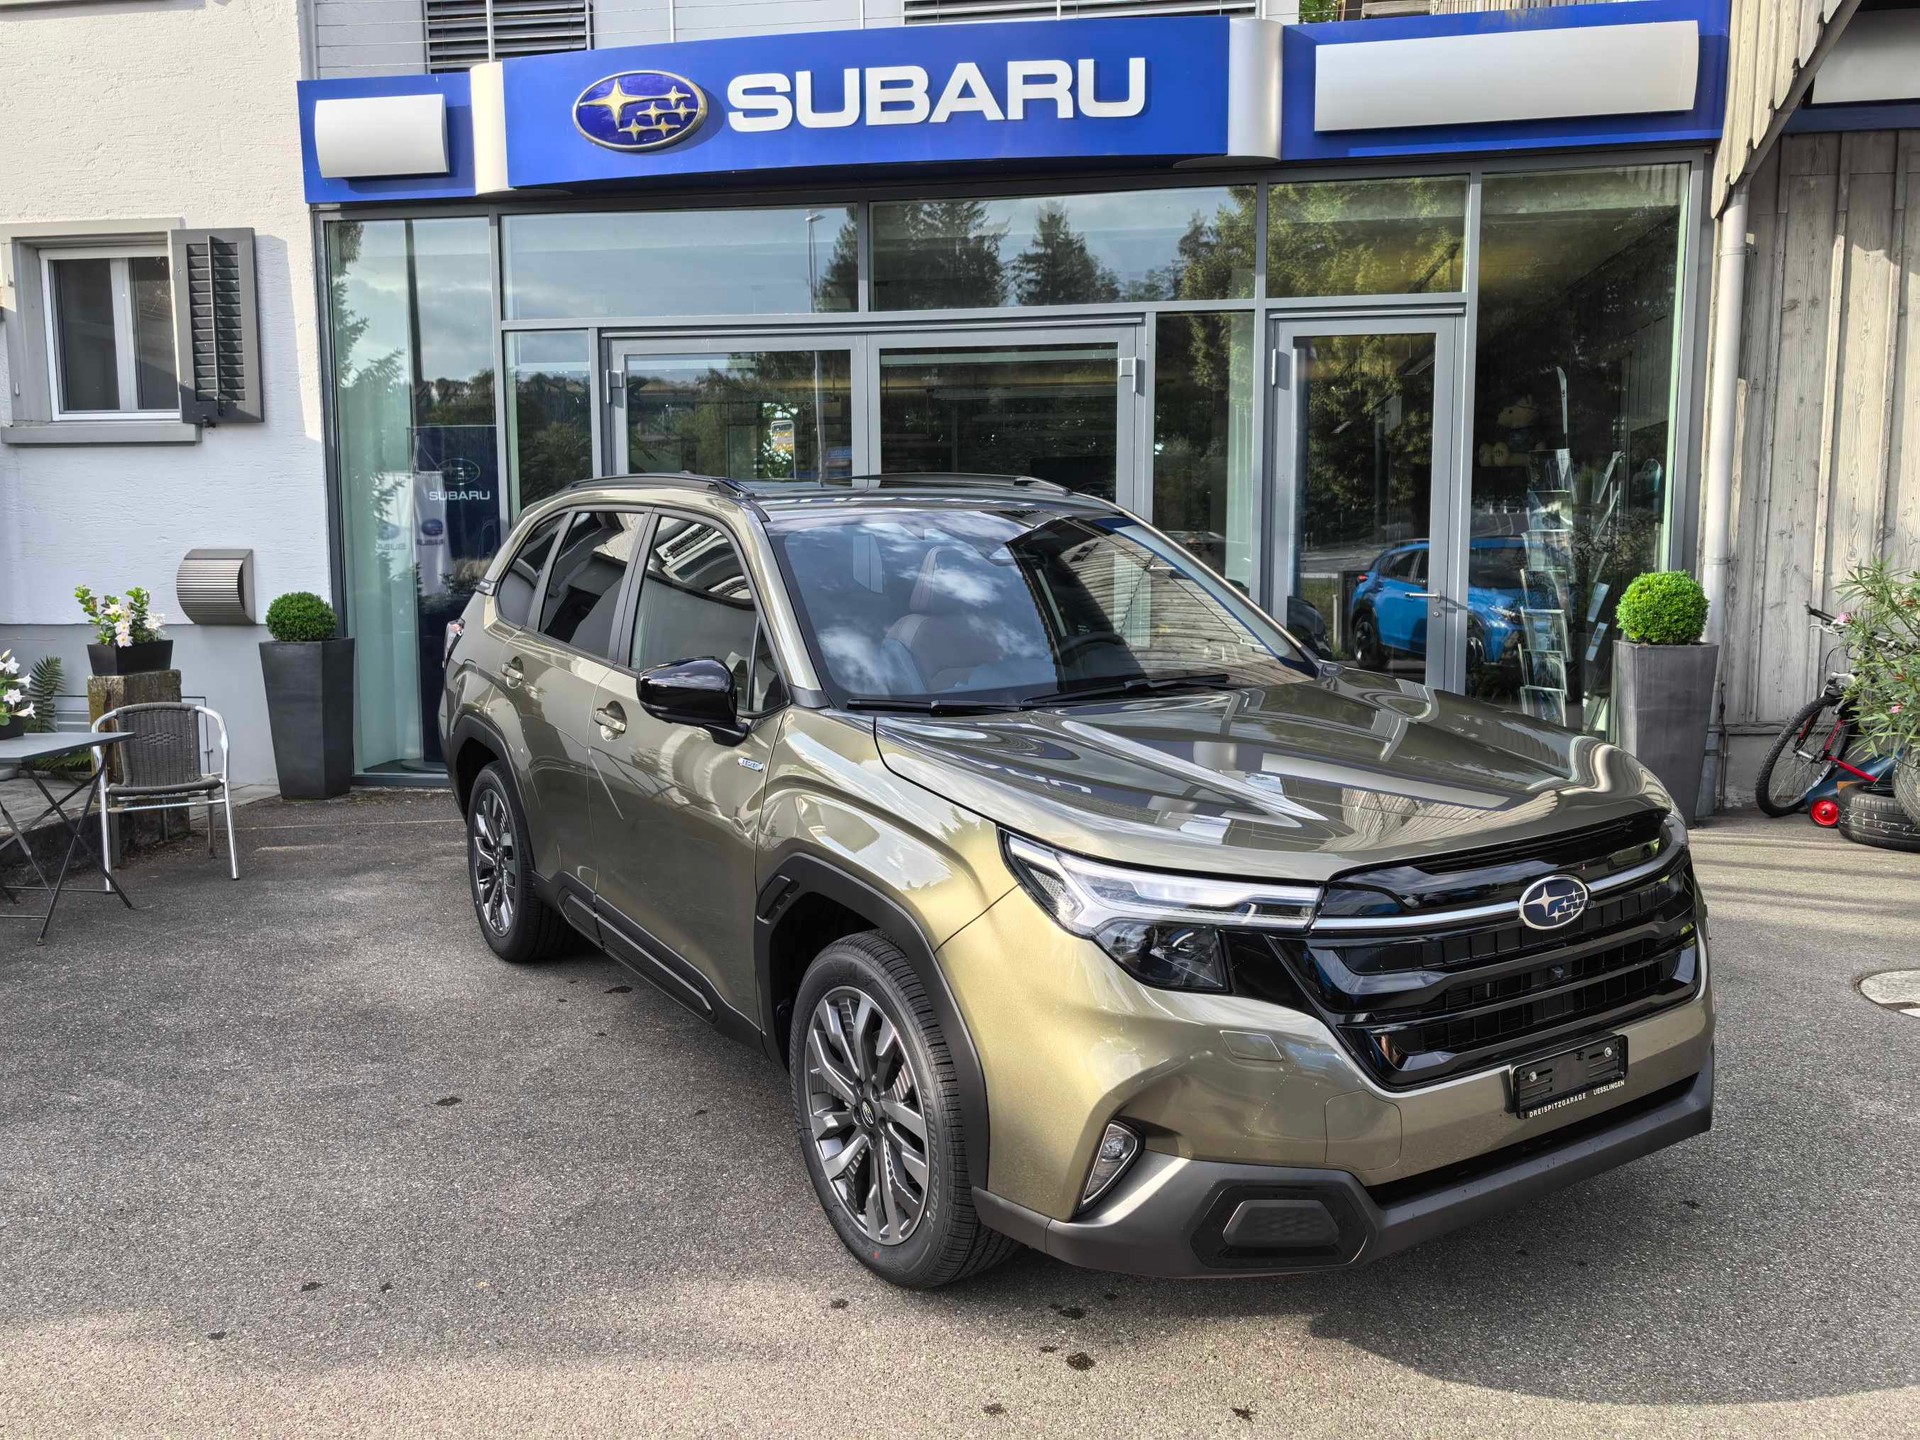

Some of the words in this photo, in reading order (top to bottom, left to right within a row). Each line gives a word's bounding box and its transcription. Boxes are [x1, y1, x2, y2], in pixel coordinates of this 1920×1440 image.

[727, 57, 1147, 133] SUBARU
[428, 490, 490, 501] SUBARU
[1529, 1093, 1587, 1118] DREISPITZGARAGE
[1593, 1080, 1625, 1096] UESSLINGEN
